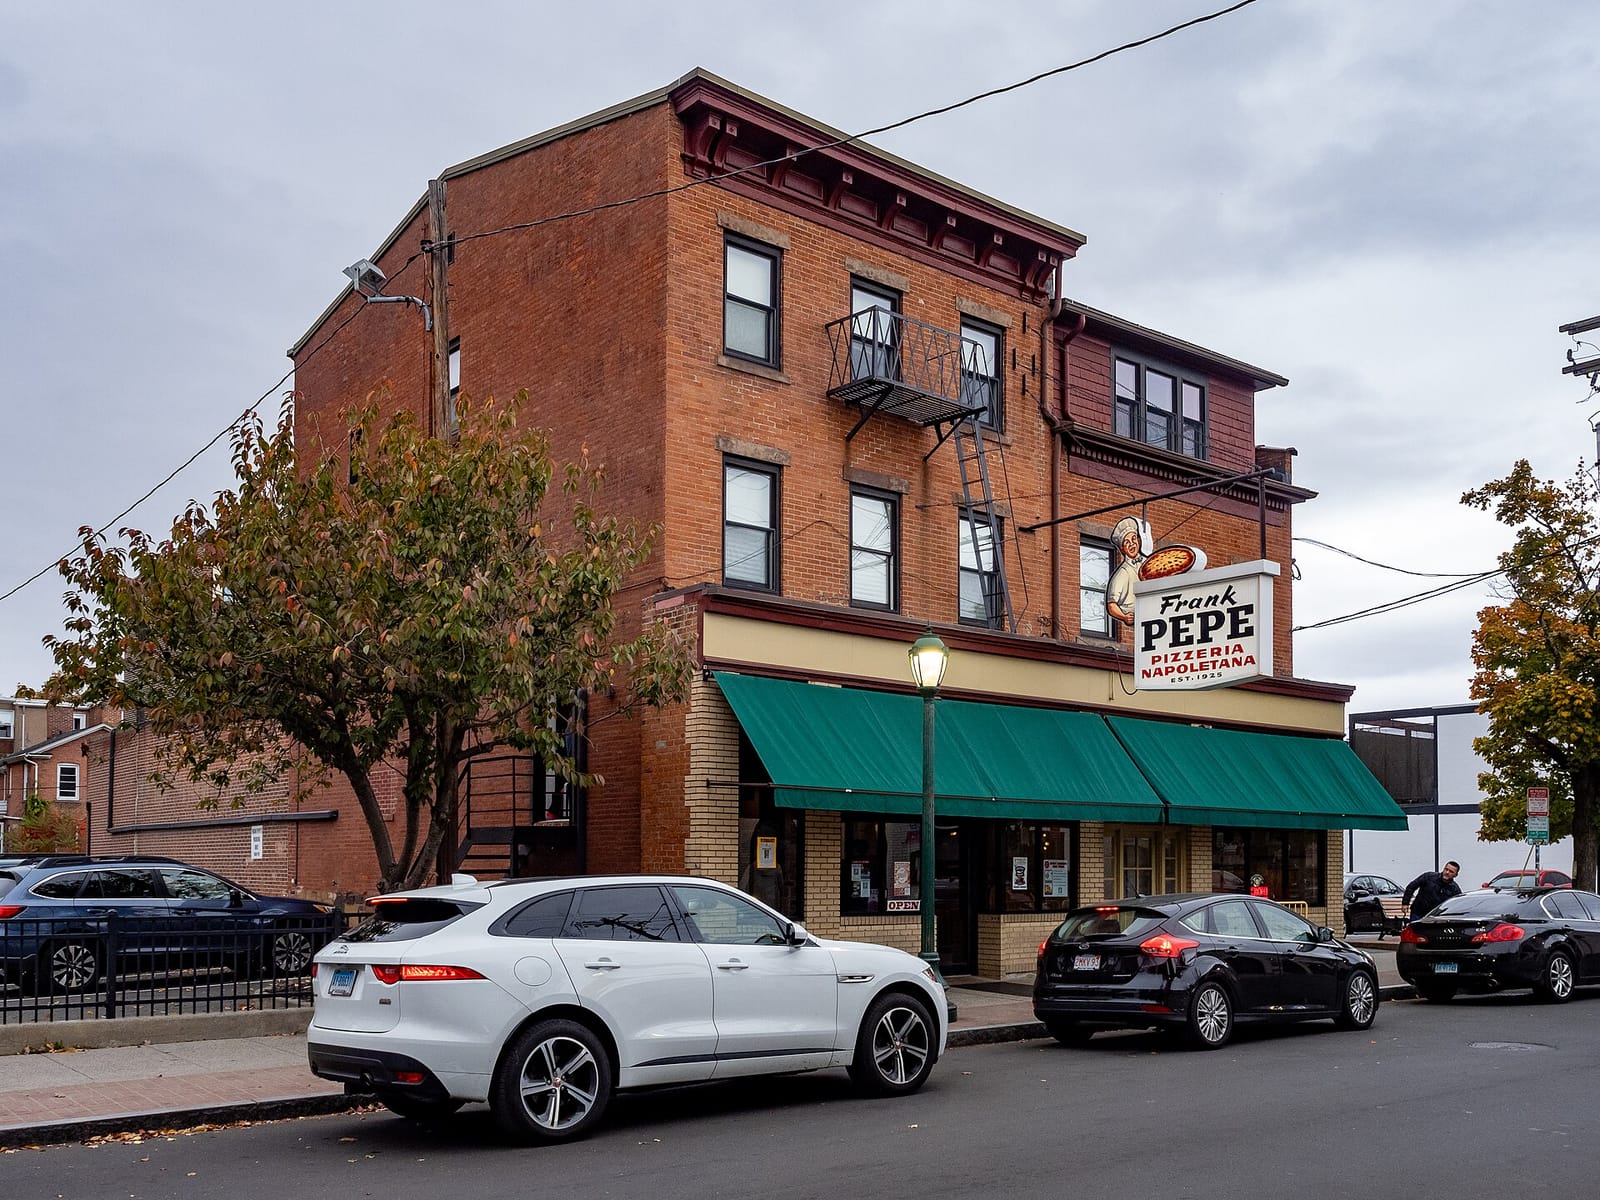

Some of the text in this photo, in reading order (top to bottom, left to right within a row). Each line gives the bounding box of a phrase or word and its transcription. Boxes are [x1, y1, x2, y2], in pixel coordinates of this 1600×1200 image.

[1160, 585, 1237, 614] Frank
[1141, 604, 1254, 652] PEPE
[1151, 644, 1244, 665] PIZZERIA
[1142, 655, 1256, 679] NAPOLETANA
[1171, 672, 1223, 683] EST. 1925
[889, 901, 919, 910] OPEN
